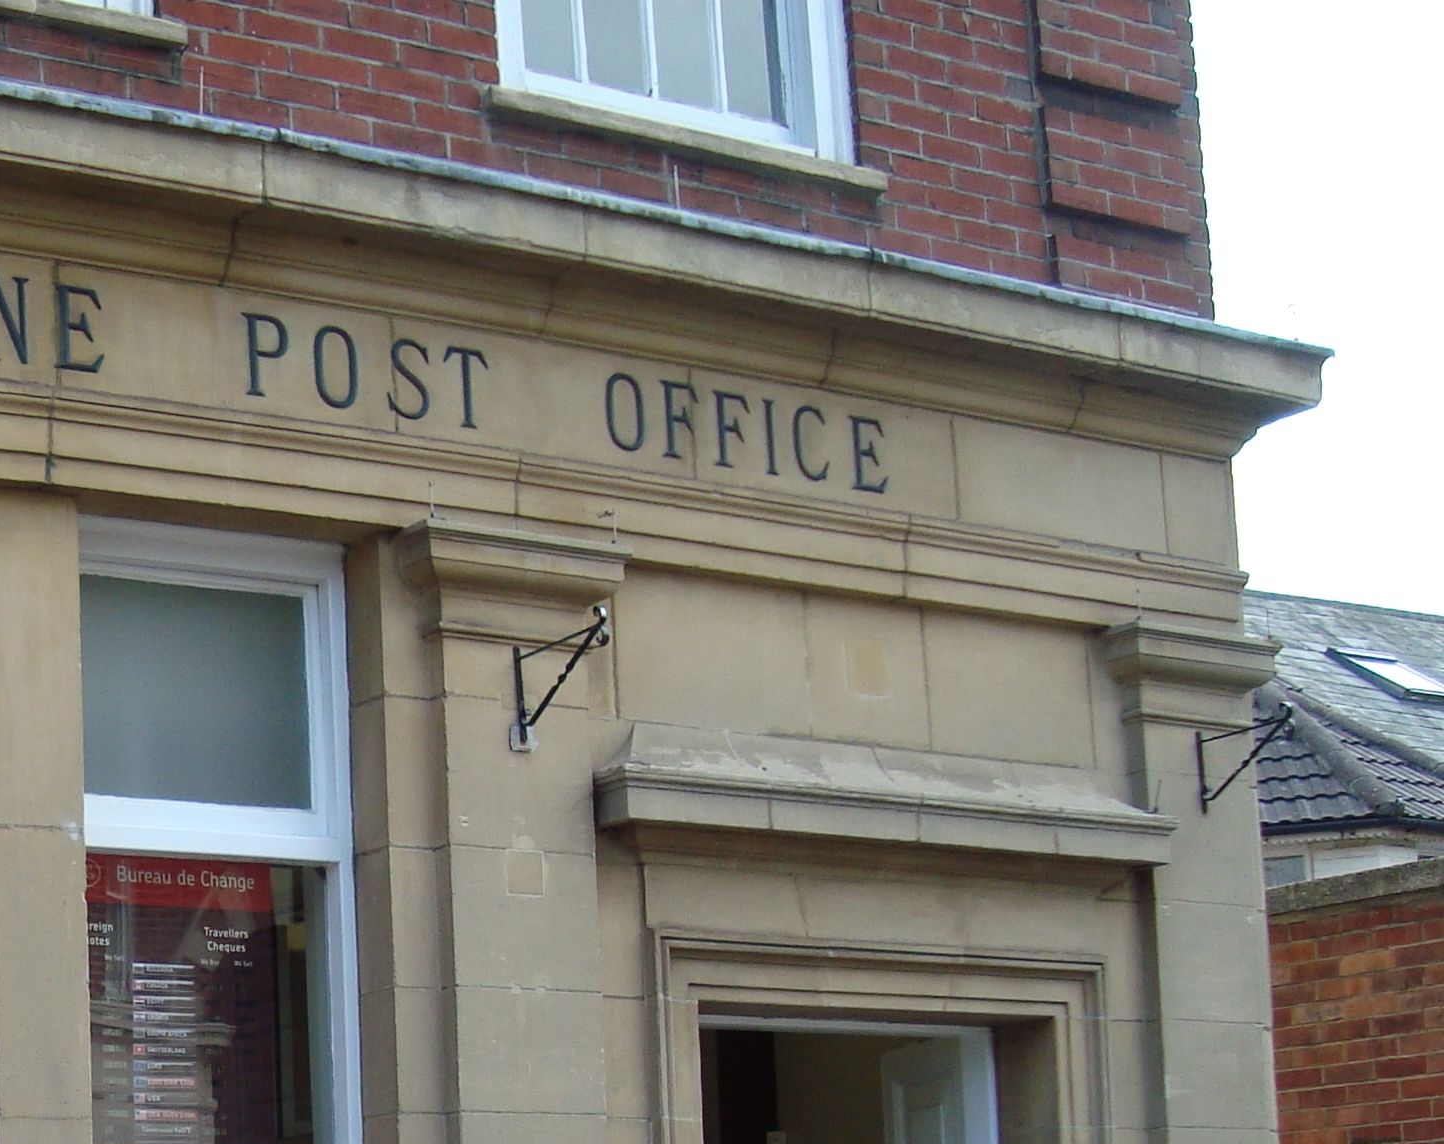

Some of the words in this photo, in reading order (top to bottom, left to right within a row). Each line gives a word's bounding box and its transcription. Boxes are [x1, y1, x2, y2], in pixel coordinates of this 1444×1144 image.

[240, 311, 489, 429] POST
[604, 371, 889, 494] OFFICE
[116, 865, 172, 885] Bureau
[177, 869, 196, 886] de
[200, 870, 255, 893] Change
[203, 926, 249, 940] Travellers
[89, 937, 110, 946] otes
[206, 940, 247, 954] Cheques
